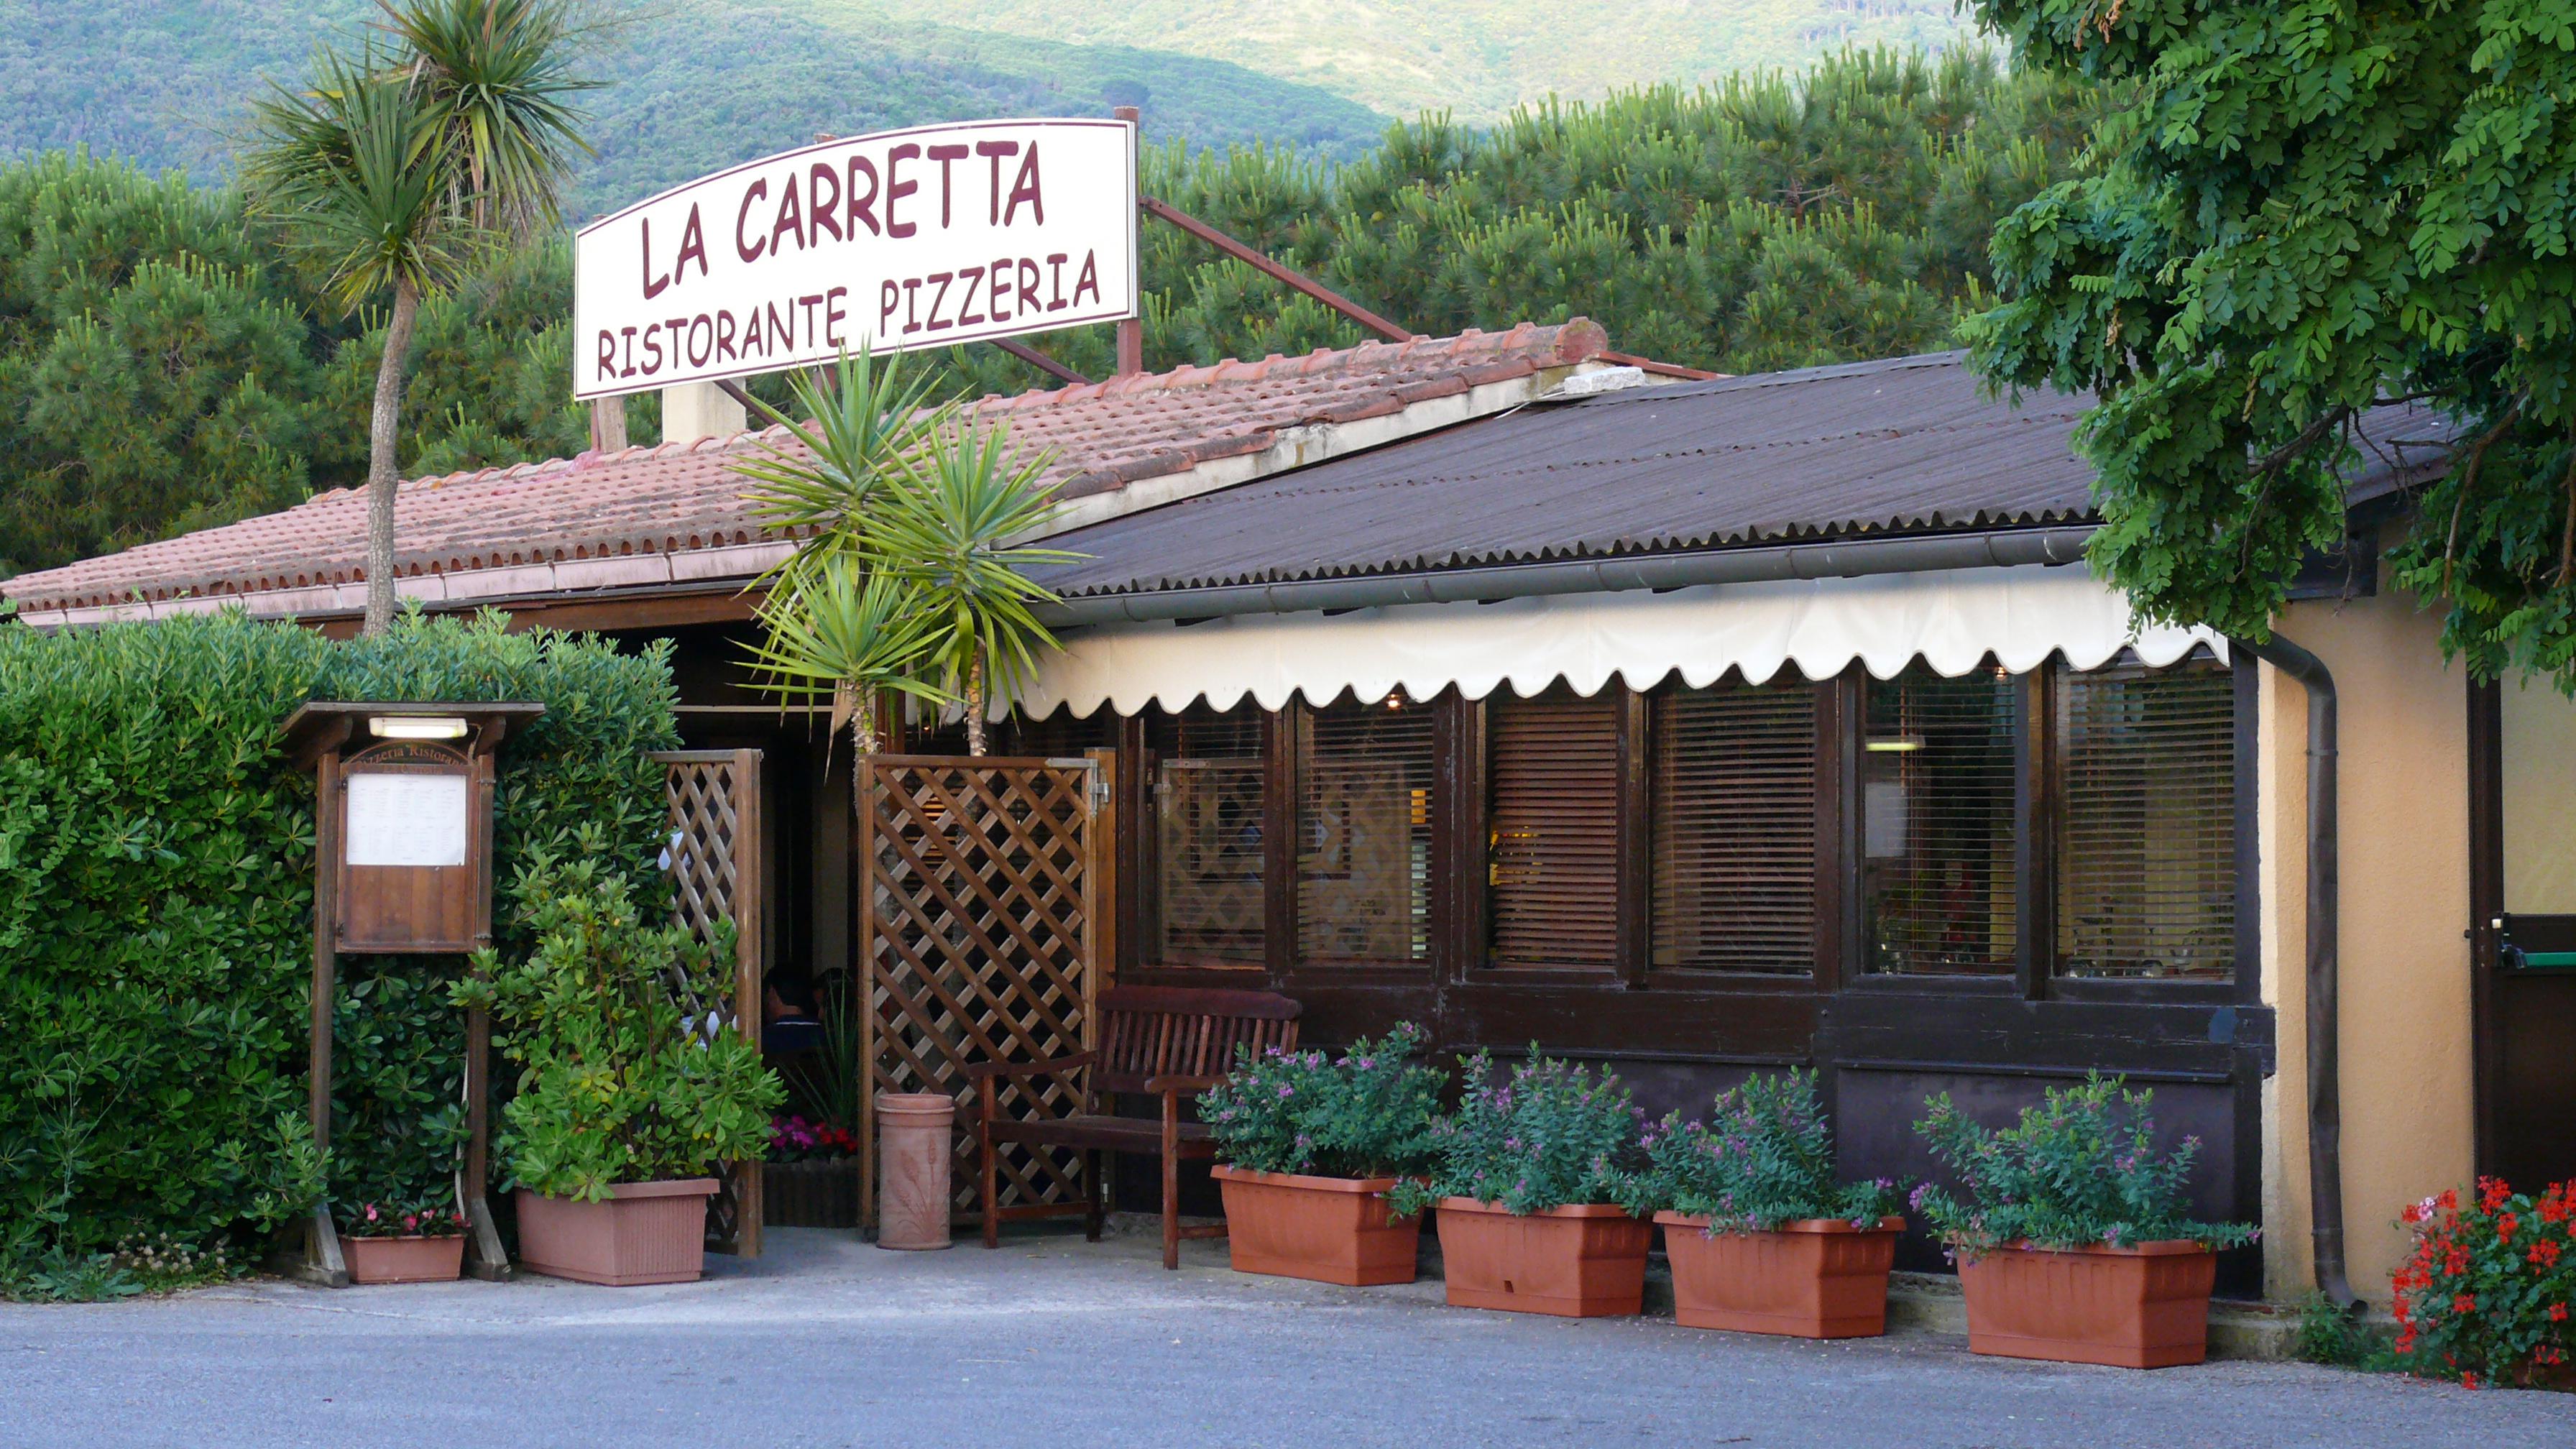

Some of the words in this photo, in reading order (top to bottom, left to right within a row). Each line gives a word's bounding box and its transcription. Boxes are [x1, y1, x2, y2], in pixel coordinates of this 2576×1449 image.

[642, 201, 708, 300] LA
[736, 139, 1044, 263] CARRETTA
[597, 286, 848, 382] RISTORANTE
[880, 248, 1100, 338] PIZZERIA
